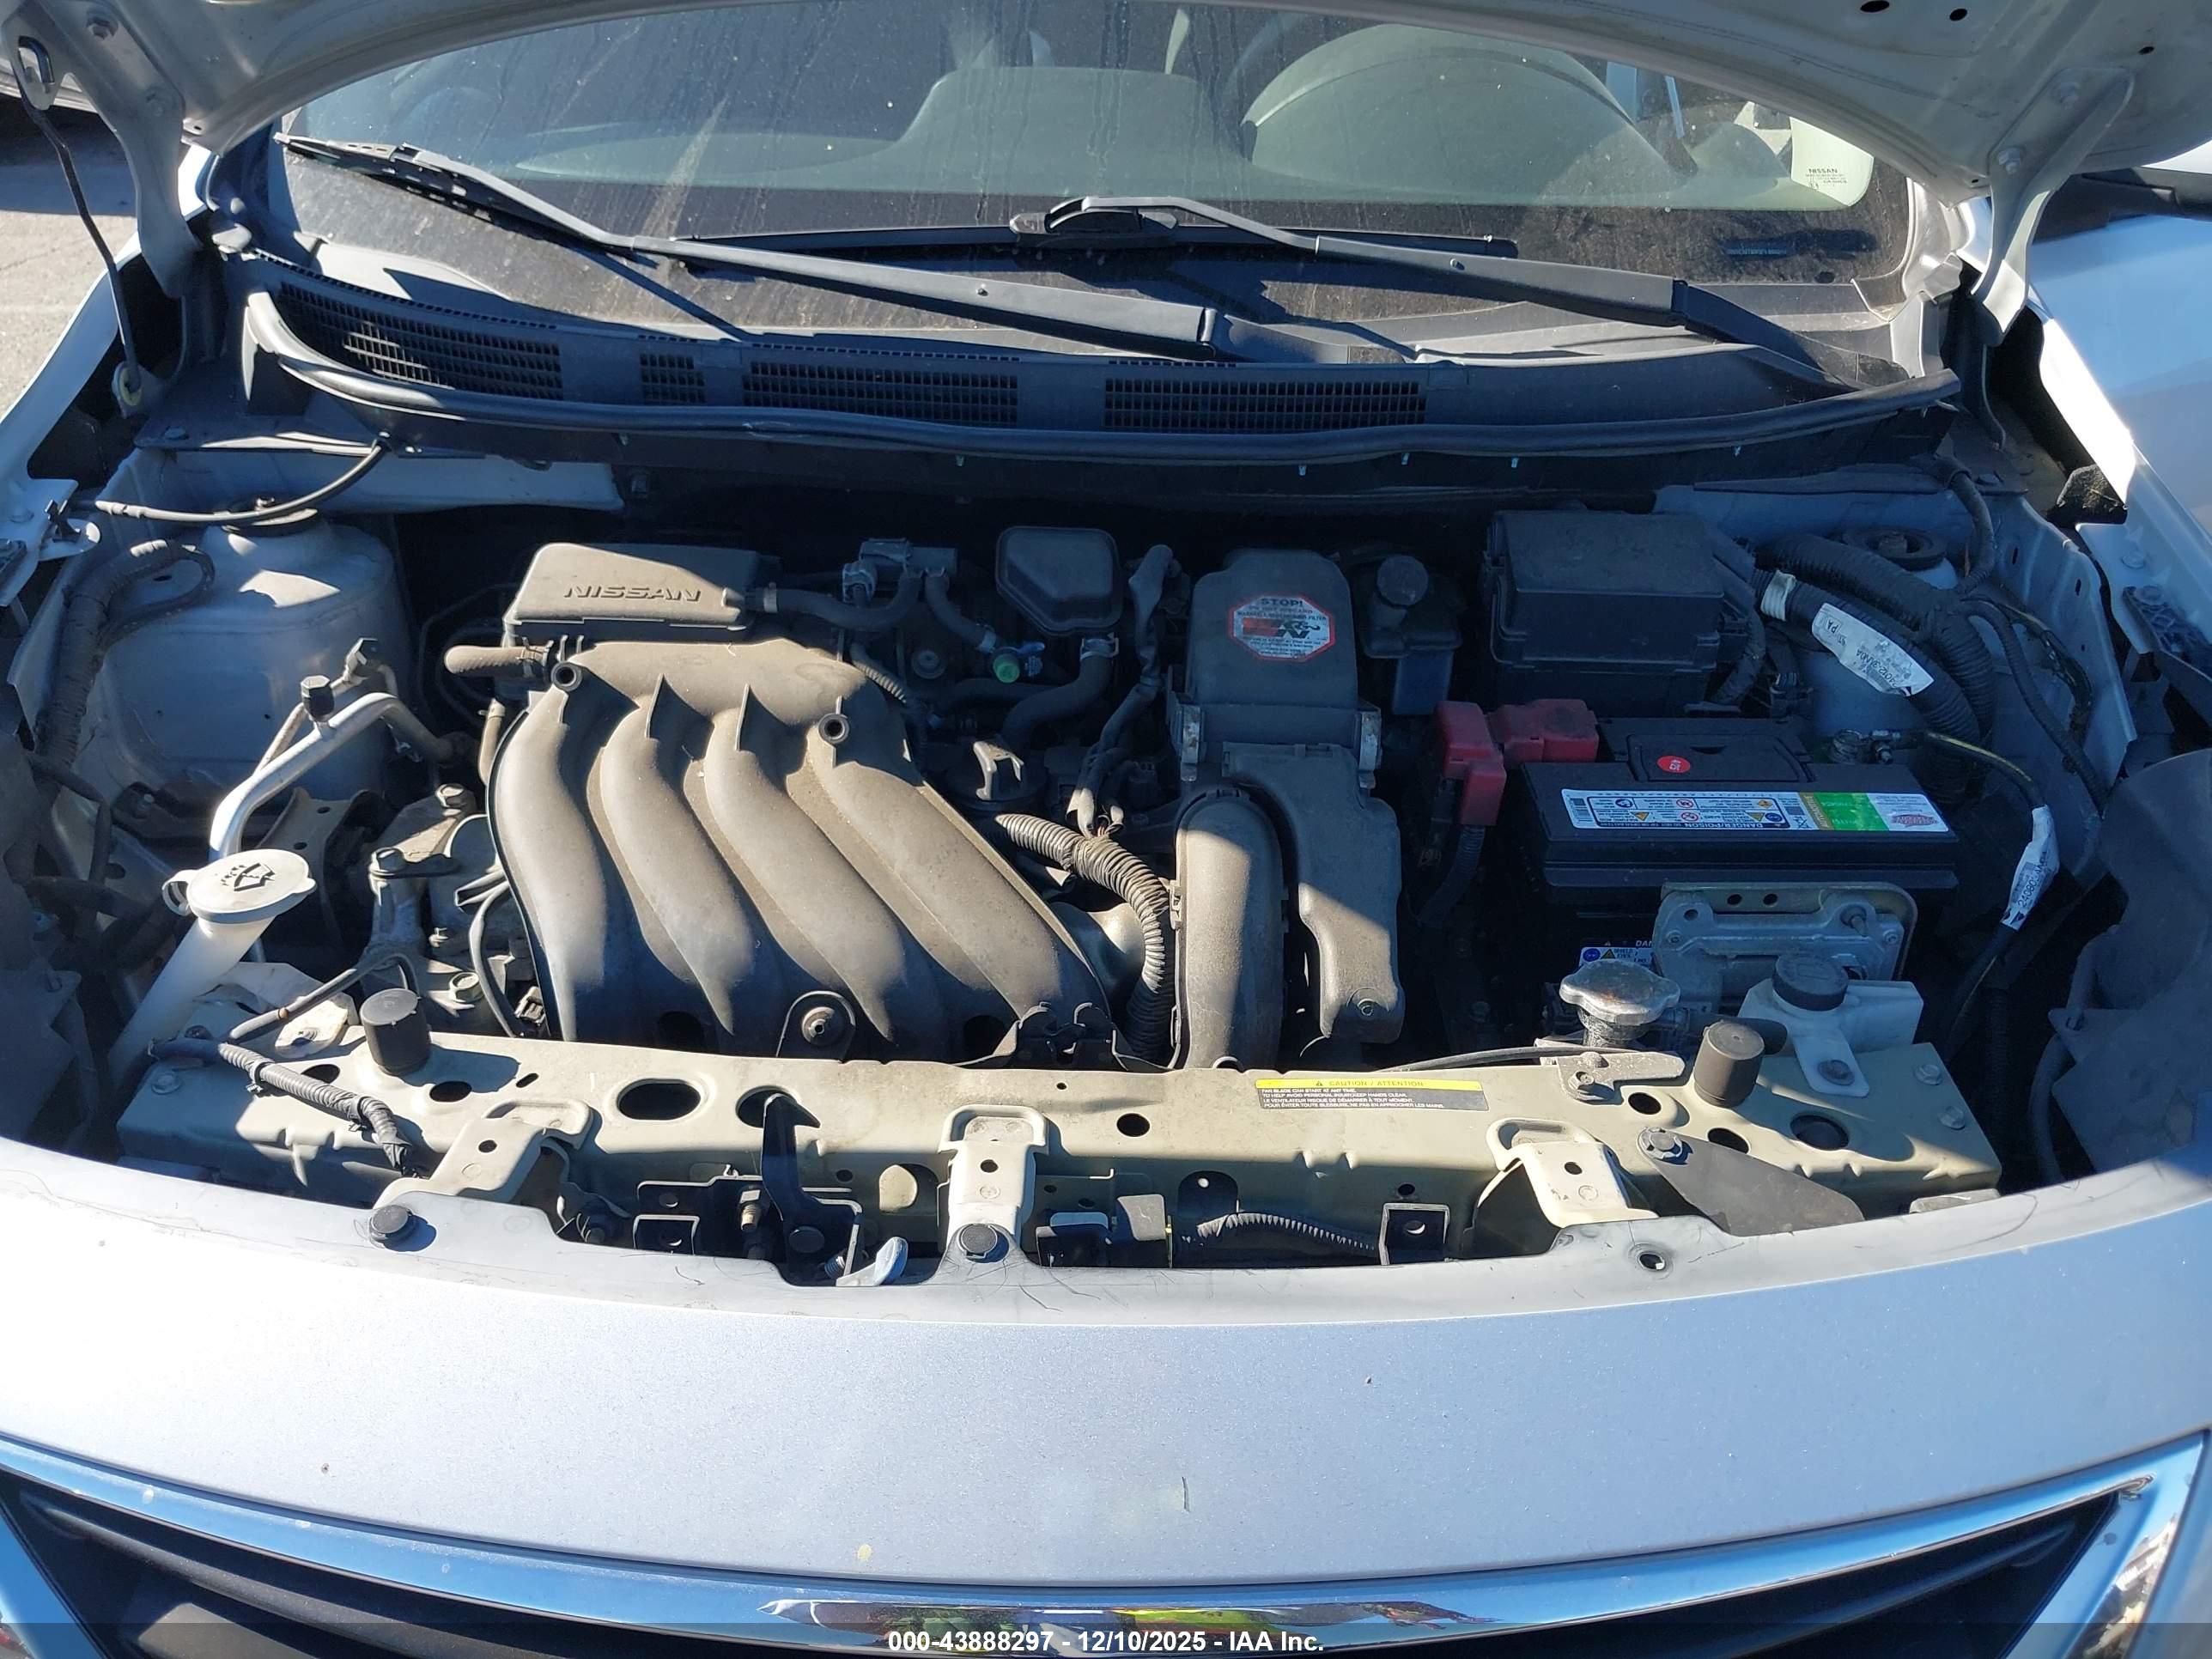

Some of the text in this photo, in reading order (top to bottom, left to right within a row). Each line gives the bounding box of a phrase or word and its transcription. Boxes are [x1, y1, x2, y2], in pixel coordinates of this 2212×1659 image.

[564, 585, 702, 602] NISSAN
[1261, 598, 1304, 607] STOP!
[1826, 621, 1838, 633] PA
